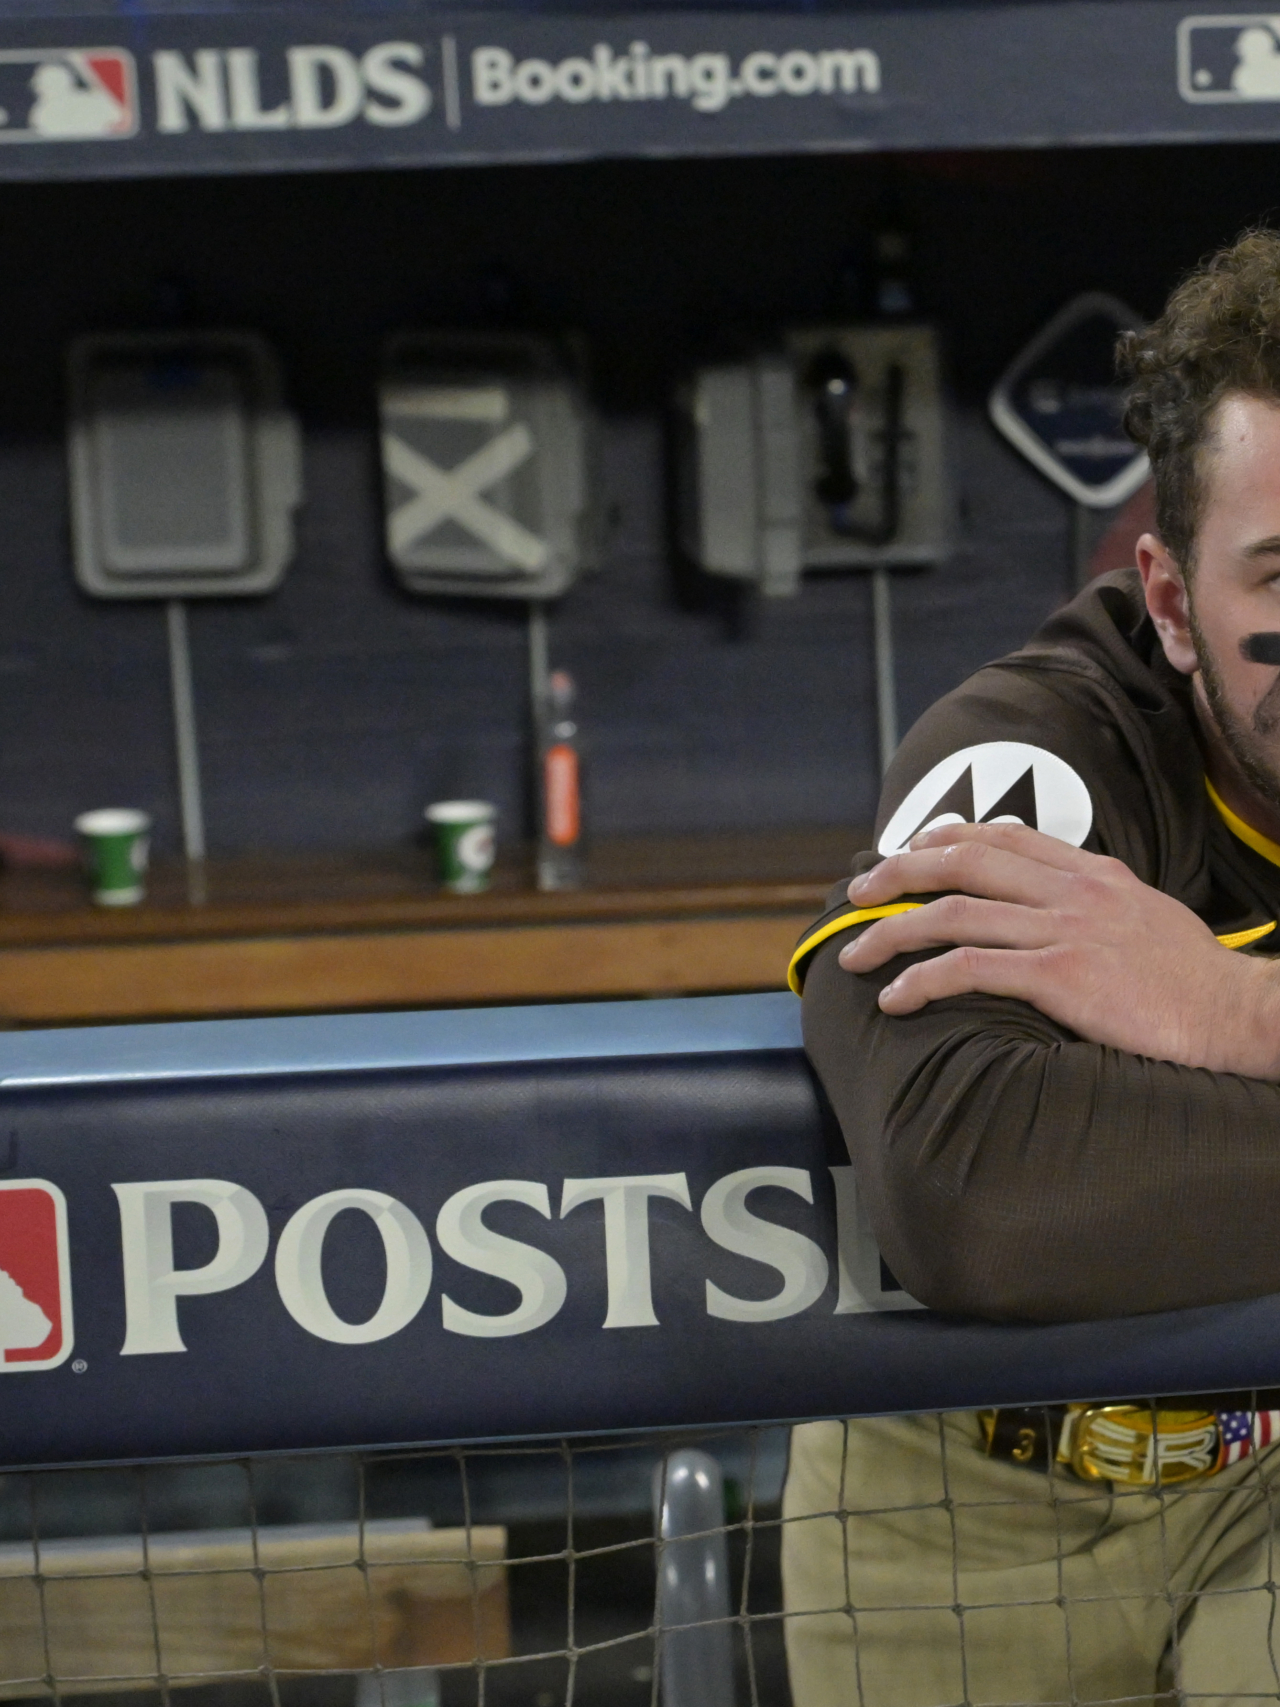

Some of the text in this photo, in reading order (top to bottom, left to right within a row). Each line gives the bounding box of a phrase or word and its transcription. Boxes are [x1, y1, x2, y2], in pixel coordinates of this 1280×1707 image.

[153, 41, 431, 134] NLDS
[472, 40, 881, 112] Booking.com
[1012, 1428, 1036, 1461] 3
